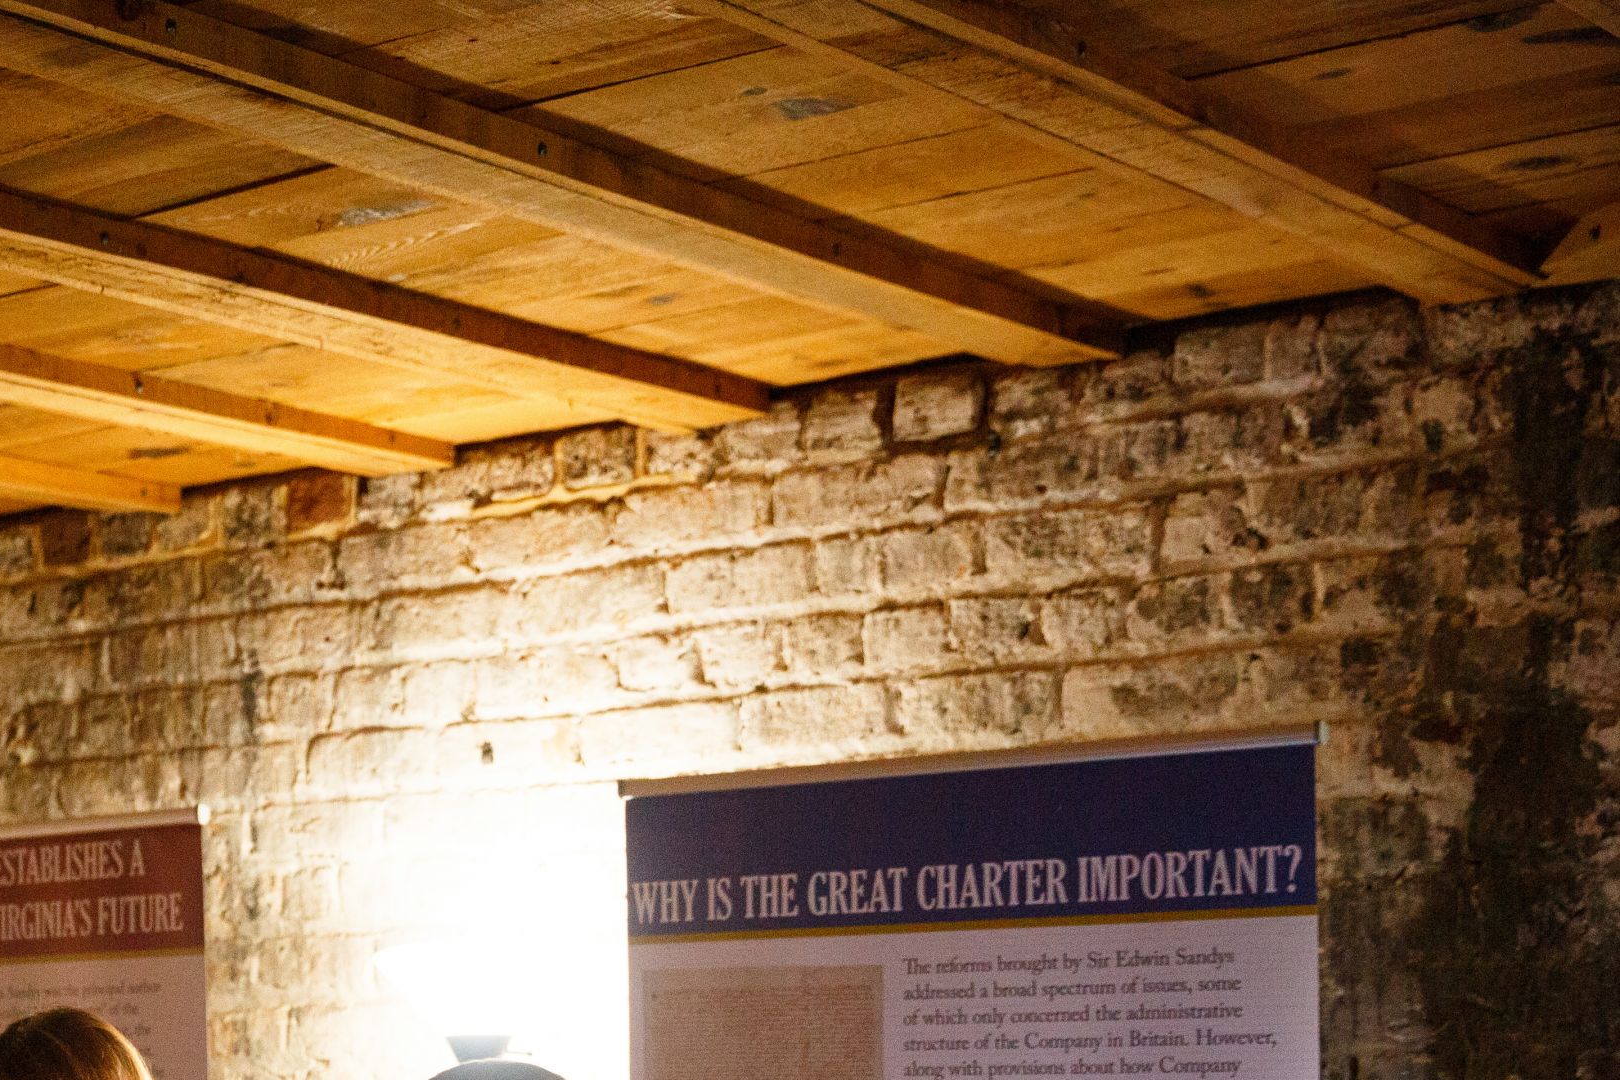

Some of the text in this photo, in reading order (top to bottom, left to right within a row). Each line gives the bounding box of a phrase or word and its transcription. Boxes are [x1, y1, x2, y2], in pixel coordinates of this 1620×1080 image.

[129, 840, 146, 877] A
[629, 847, 1302, 924] WHY IS THE GREAT CHARTER IMPORTANT?
[98, 892, 183, 934] FUTURE
[902, 946, 1234, 975] The reforms brought by Sir Edwin Sandys
